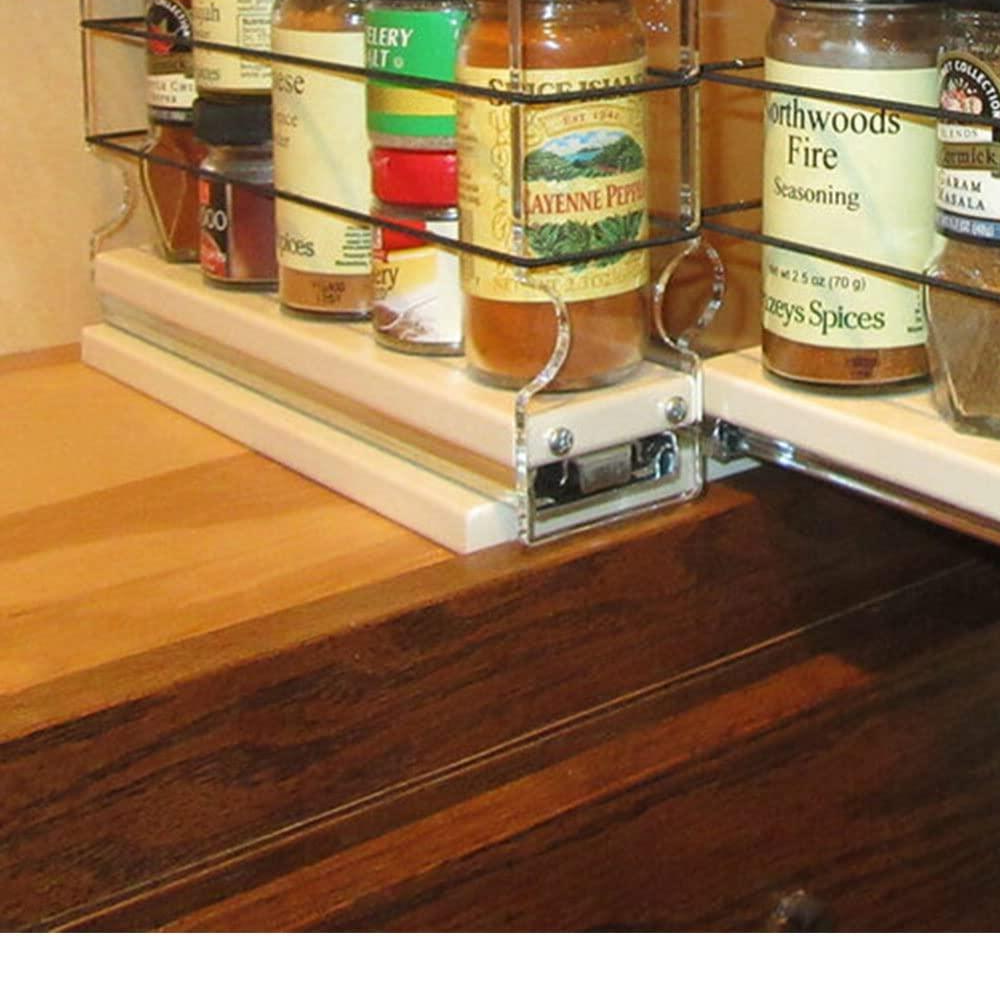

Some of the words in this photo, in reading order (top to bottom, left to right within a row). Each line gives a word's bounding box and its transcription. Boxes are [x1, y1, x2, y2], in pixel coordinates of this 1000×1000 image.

[787, 134, 839, 171] Fire
[773, 175, 861, 212] Seasoning
[808, 299, 886, 336] Spices
